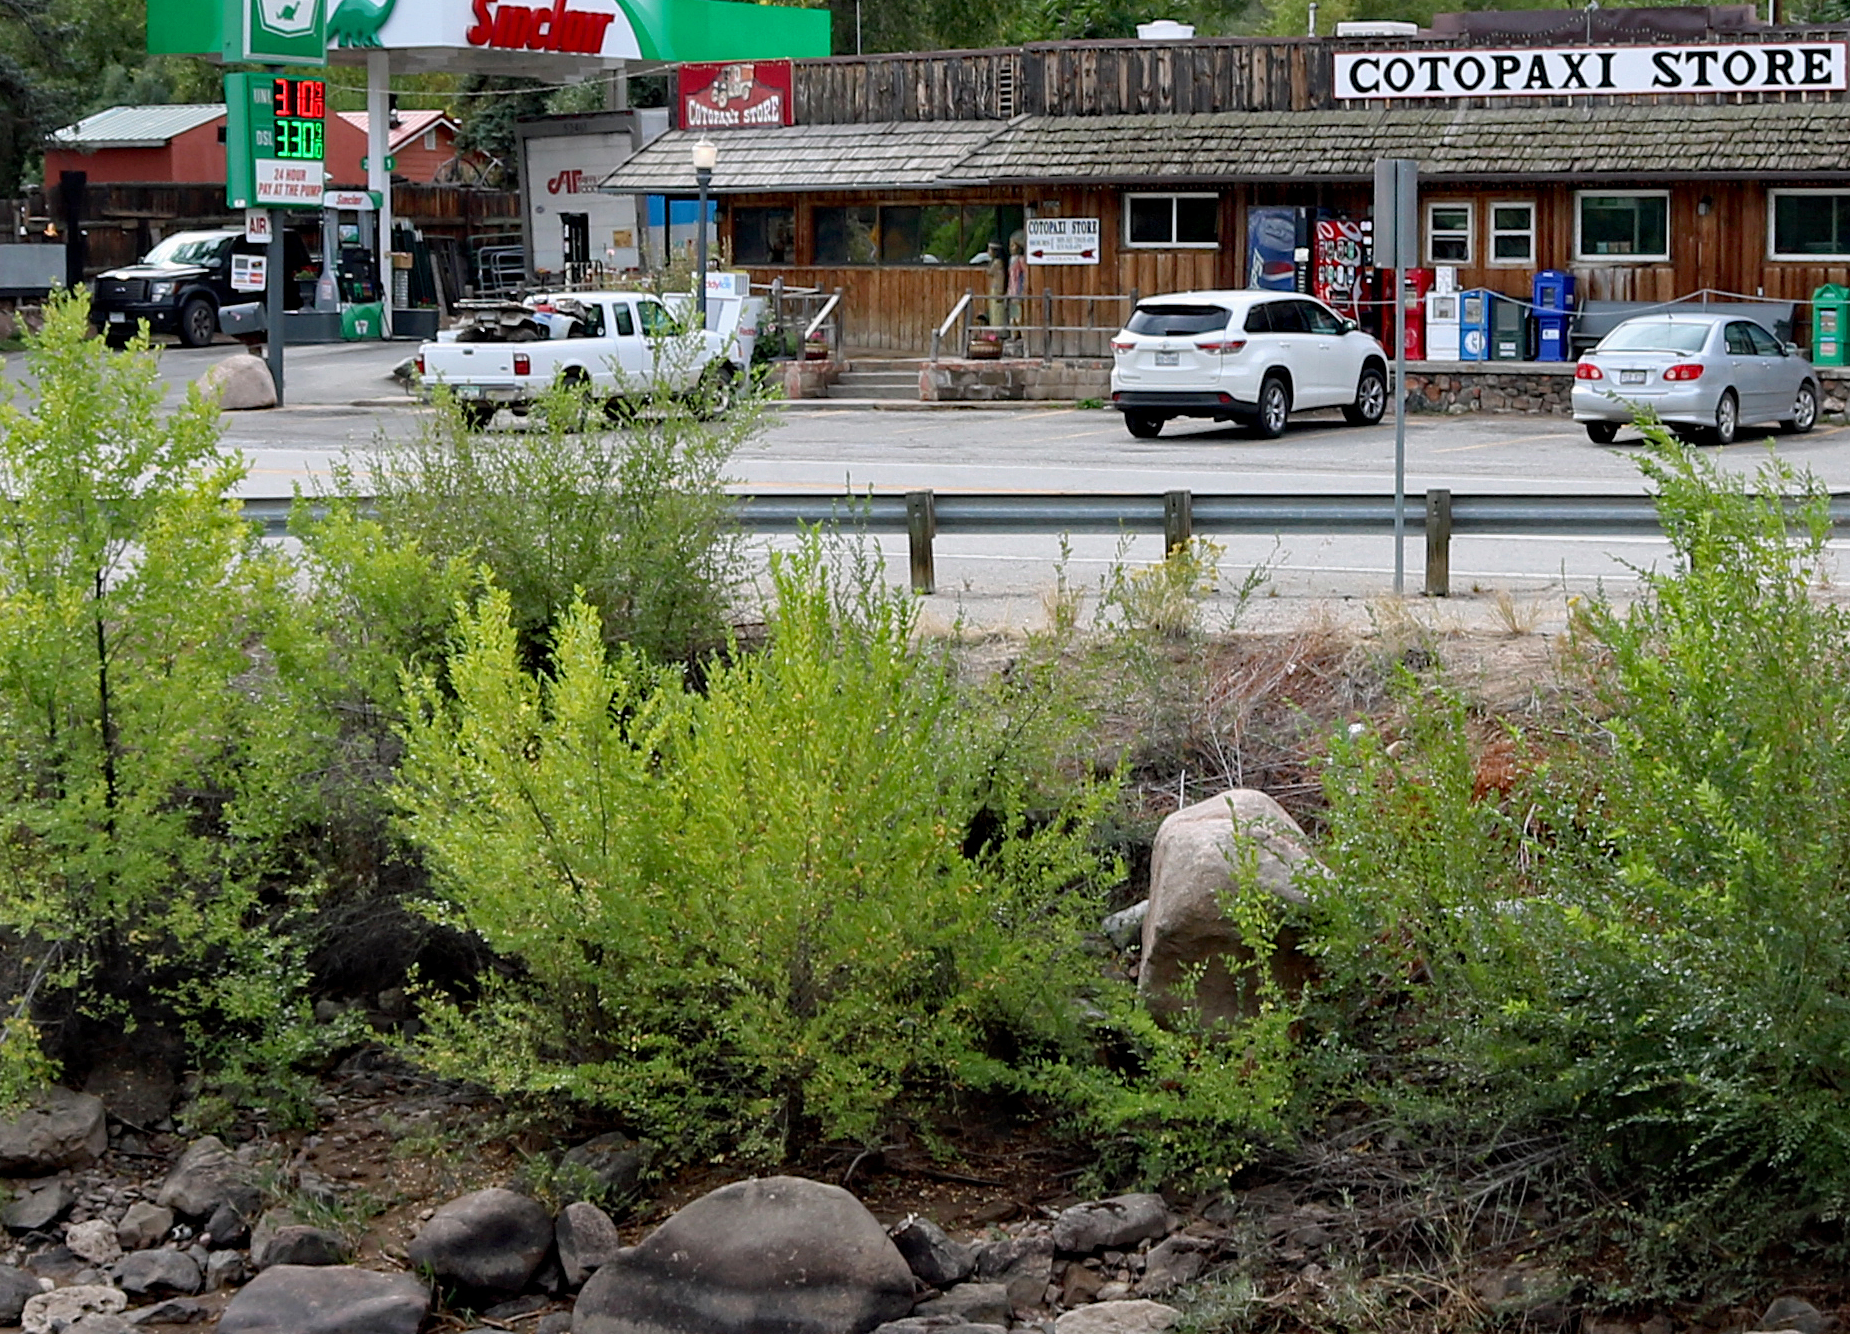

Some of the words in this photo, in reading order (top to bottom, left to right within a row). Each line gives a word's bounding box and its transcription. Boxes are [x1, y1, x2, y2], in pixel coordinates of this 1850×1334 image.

[1349, 52, 1618, 94] COTOPAXI
[1650, 48, 1833, 88] STORE
[253, 87, 273, 105] UNL
[689, 99, 740, 127] COTOPAXI
[743, 95, 780, 123] STORE
[256, 130, 273, 146] DSL
[273, 168, 285, 181] 24
[286, 169, 307, 182] HOUR
[258, 182, 272, 195] PAY
[273, 183, 283, 195] AT
[285, 184, 299, 196] THE
[300, 184, 322, 197] PUMP
[336, 194, 363, 205] Sinclair
[250, 217, 267, 234] AIR
[1028, 220, 1067, 235] COTOPAXI
[1071, 220, 1098, 235] STORE
